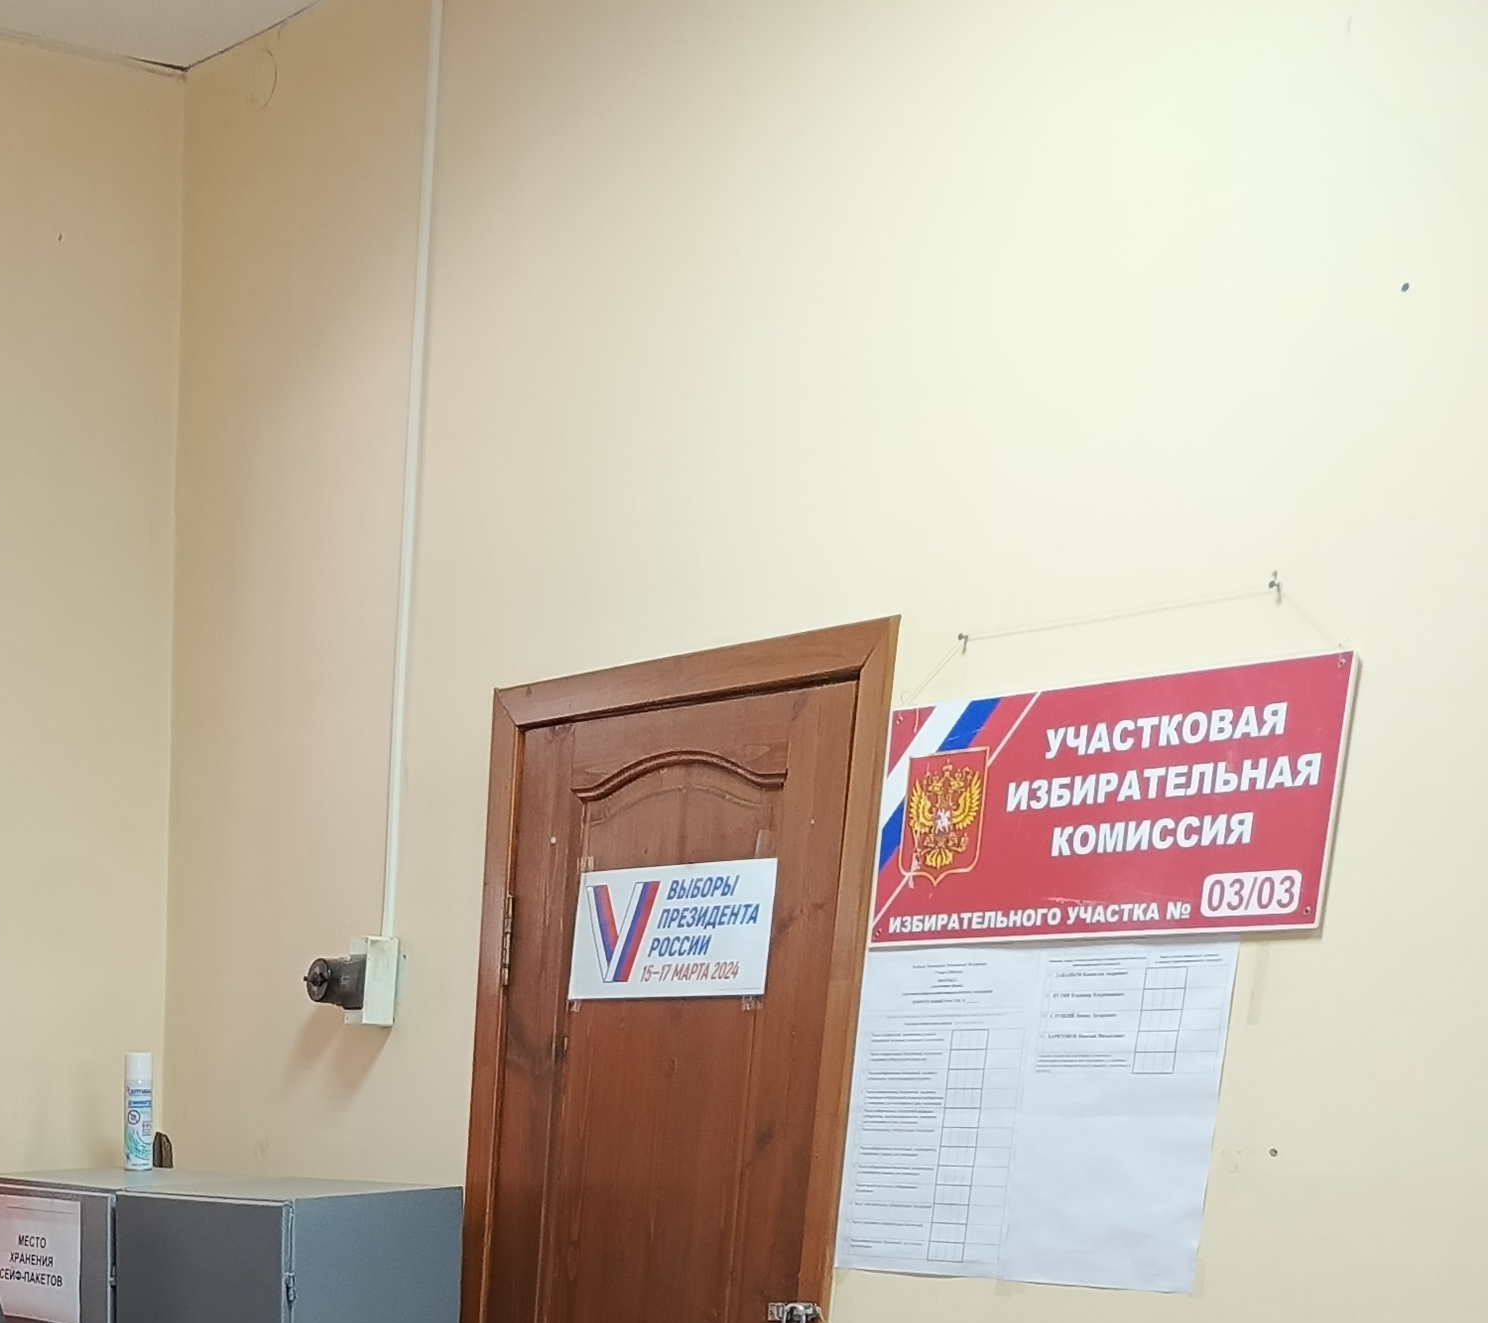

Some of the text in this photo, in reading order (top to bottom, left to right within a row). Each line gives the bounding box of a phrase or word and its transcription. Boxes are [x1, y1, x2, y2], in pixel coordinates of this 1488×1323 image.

[1045, 702, 1289, 760] УЧАСТКОВАЯ
[1005, 752, 1323, 812] ИЗБИРАТЕЛЬНАЯ
[1050, 811, 1255, 857] КОМИССИЯ
[666, 875, 741, 901] ВЫБОРЫ
[656, 903, 761, 930] ПРЕЗИДЕНТА
[888, 874, 1297, 934] ИЗБИРАТЕЛЬНОГО УЧАСТКА № 03/03
[648, 935, 713, 958] РОССИИ
[672, 962, 710, 982] МАРТА
[710, 961, 740, 981] 2024
[18, 1234, 47, 1249] МЕСТО
[9, 1251, 54, 1268] ХРАНЕНИЯ
[0, 1267, 63, 1287] СЕЙФ-ПАКЕТОВ
